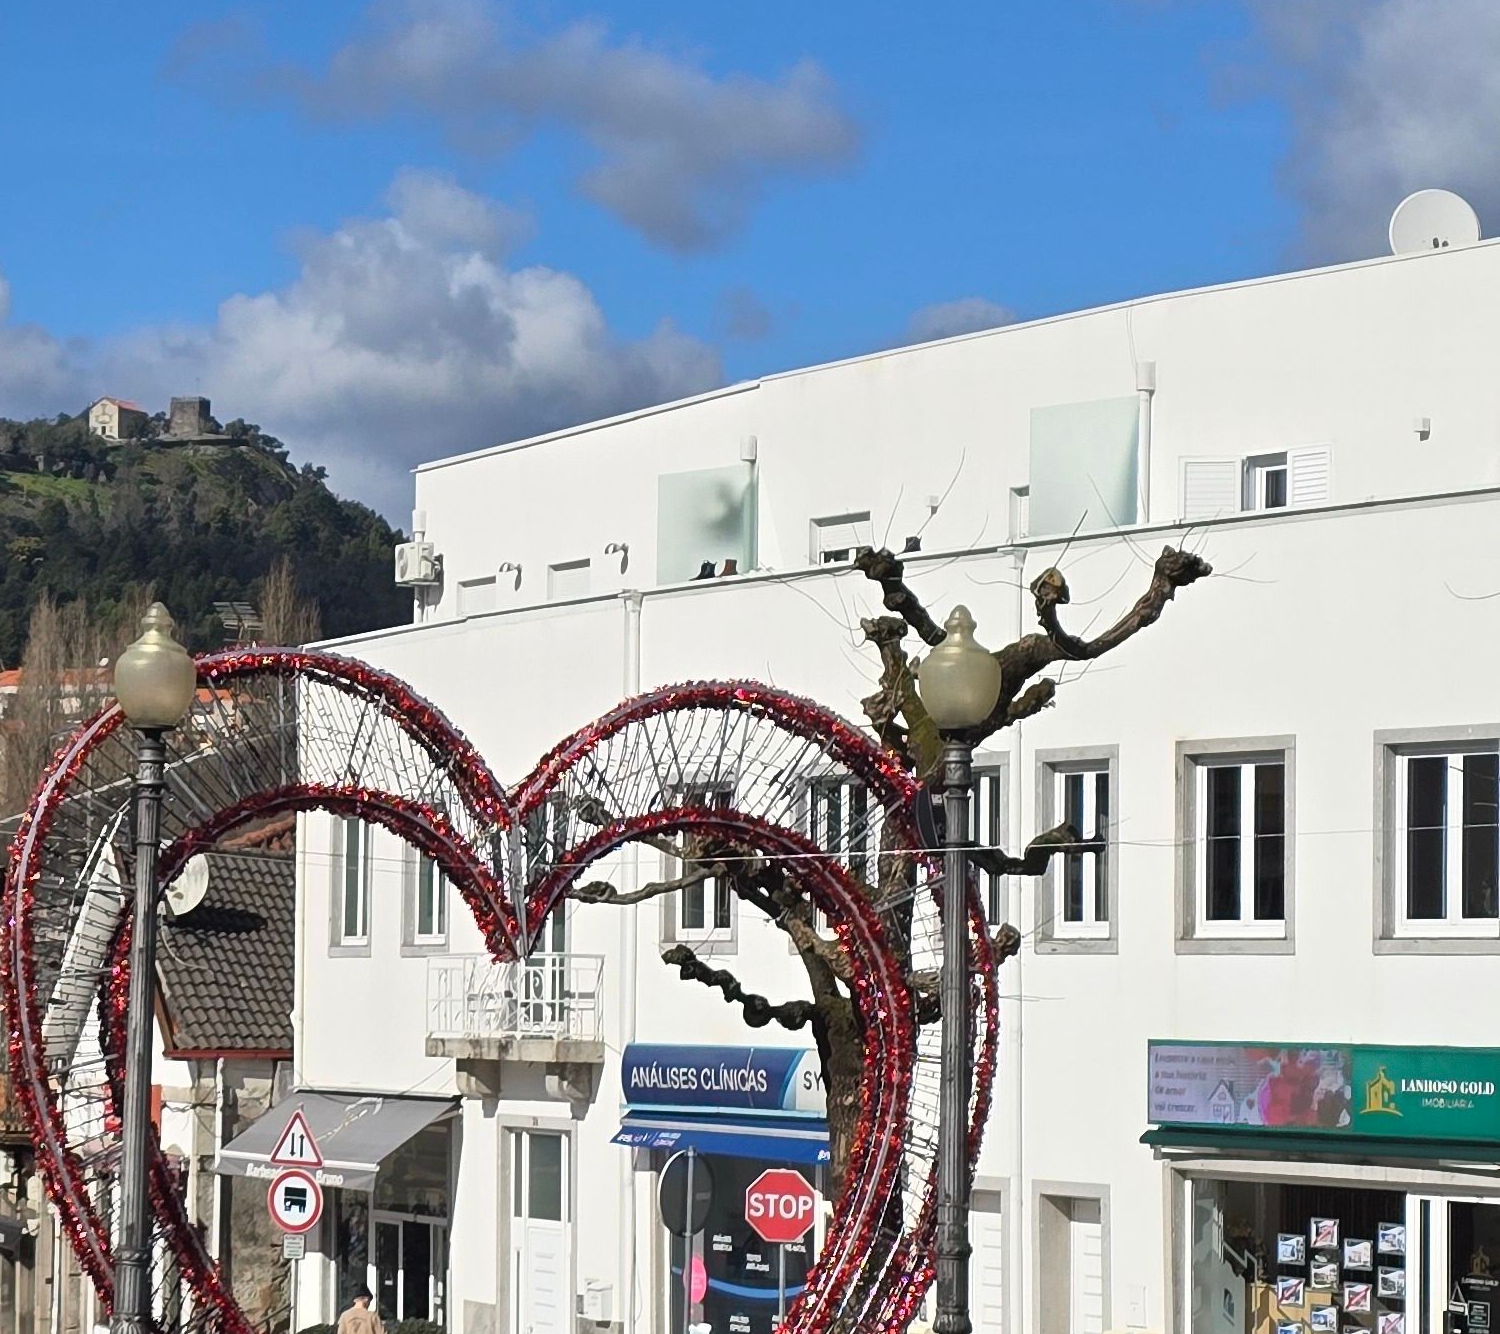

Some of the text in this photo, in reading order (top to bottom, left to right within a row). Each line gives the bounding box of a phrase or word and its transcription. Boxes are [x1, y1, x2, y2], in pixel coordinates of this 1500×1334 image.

[631, 1061, 768, 1092] ANÁLISES CLÍNICAS
[1460, 1081, 1495, 1095] GOLD
[749, 1192, 813, 1220] STOP
